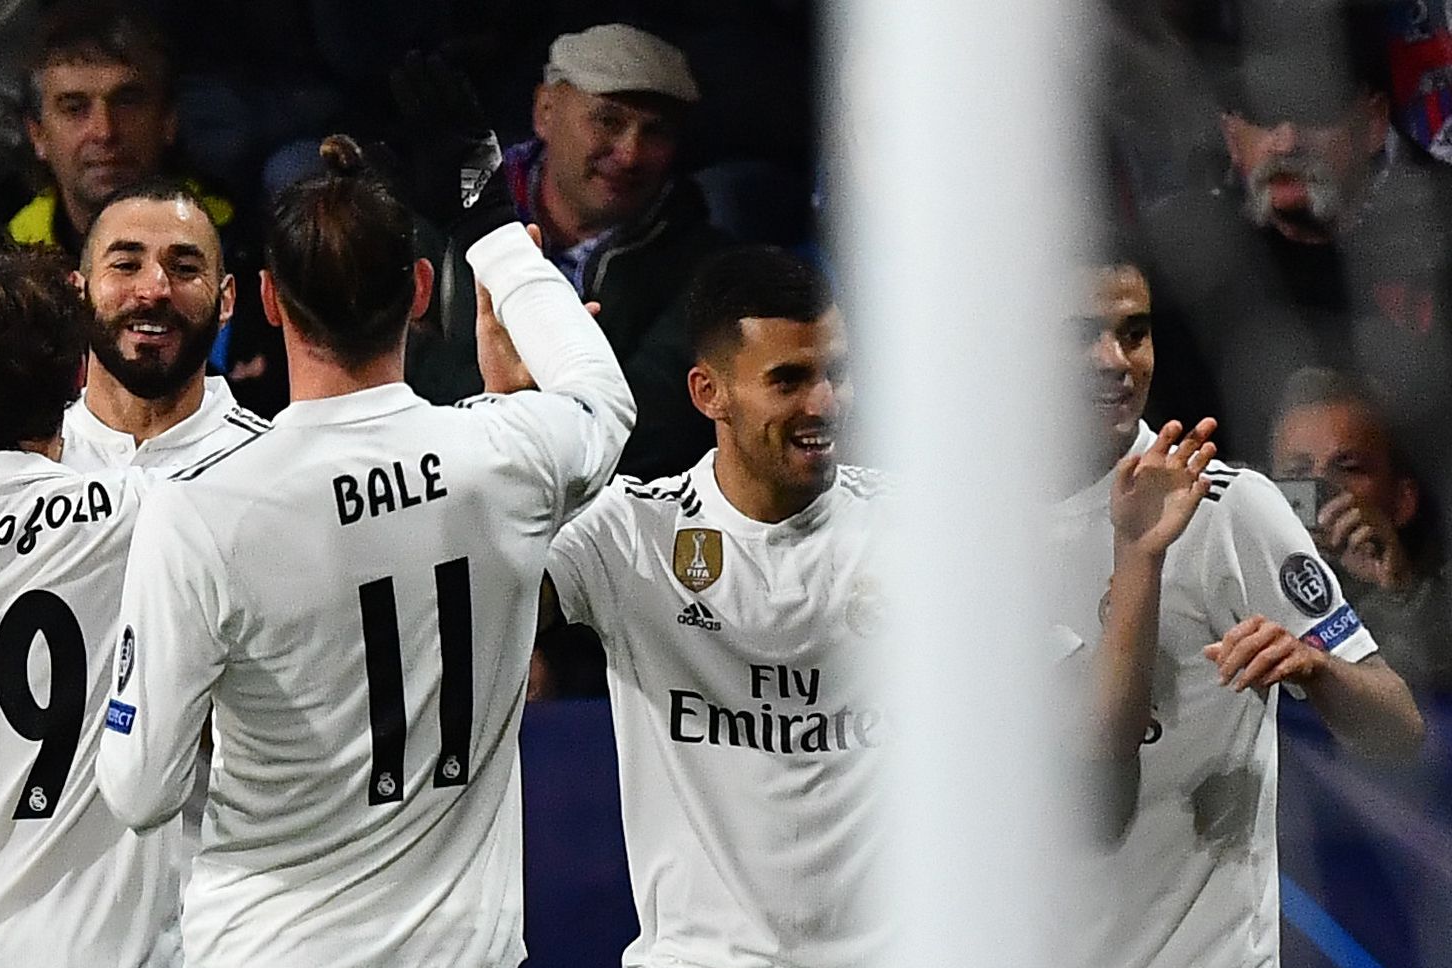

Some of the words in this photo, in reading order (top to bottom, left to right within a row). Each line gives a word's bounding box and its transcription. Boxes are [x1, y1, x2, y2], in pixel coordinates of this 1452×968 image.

[333, 453, 447, 526] BALE
[687, 568, 709, 578] FIFA
[1302, 579, 1323, 602] 13
[677, 614, 721, 631] adidas
[1319, 609, 1358, 643] RESPE
[359, 556, 474, 806] 11
[749, 664, 820, 705] Fly
[669, 689, 881, 754] Emirate
